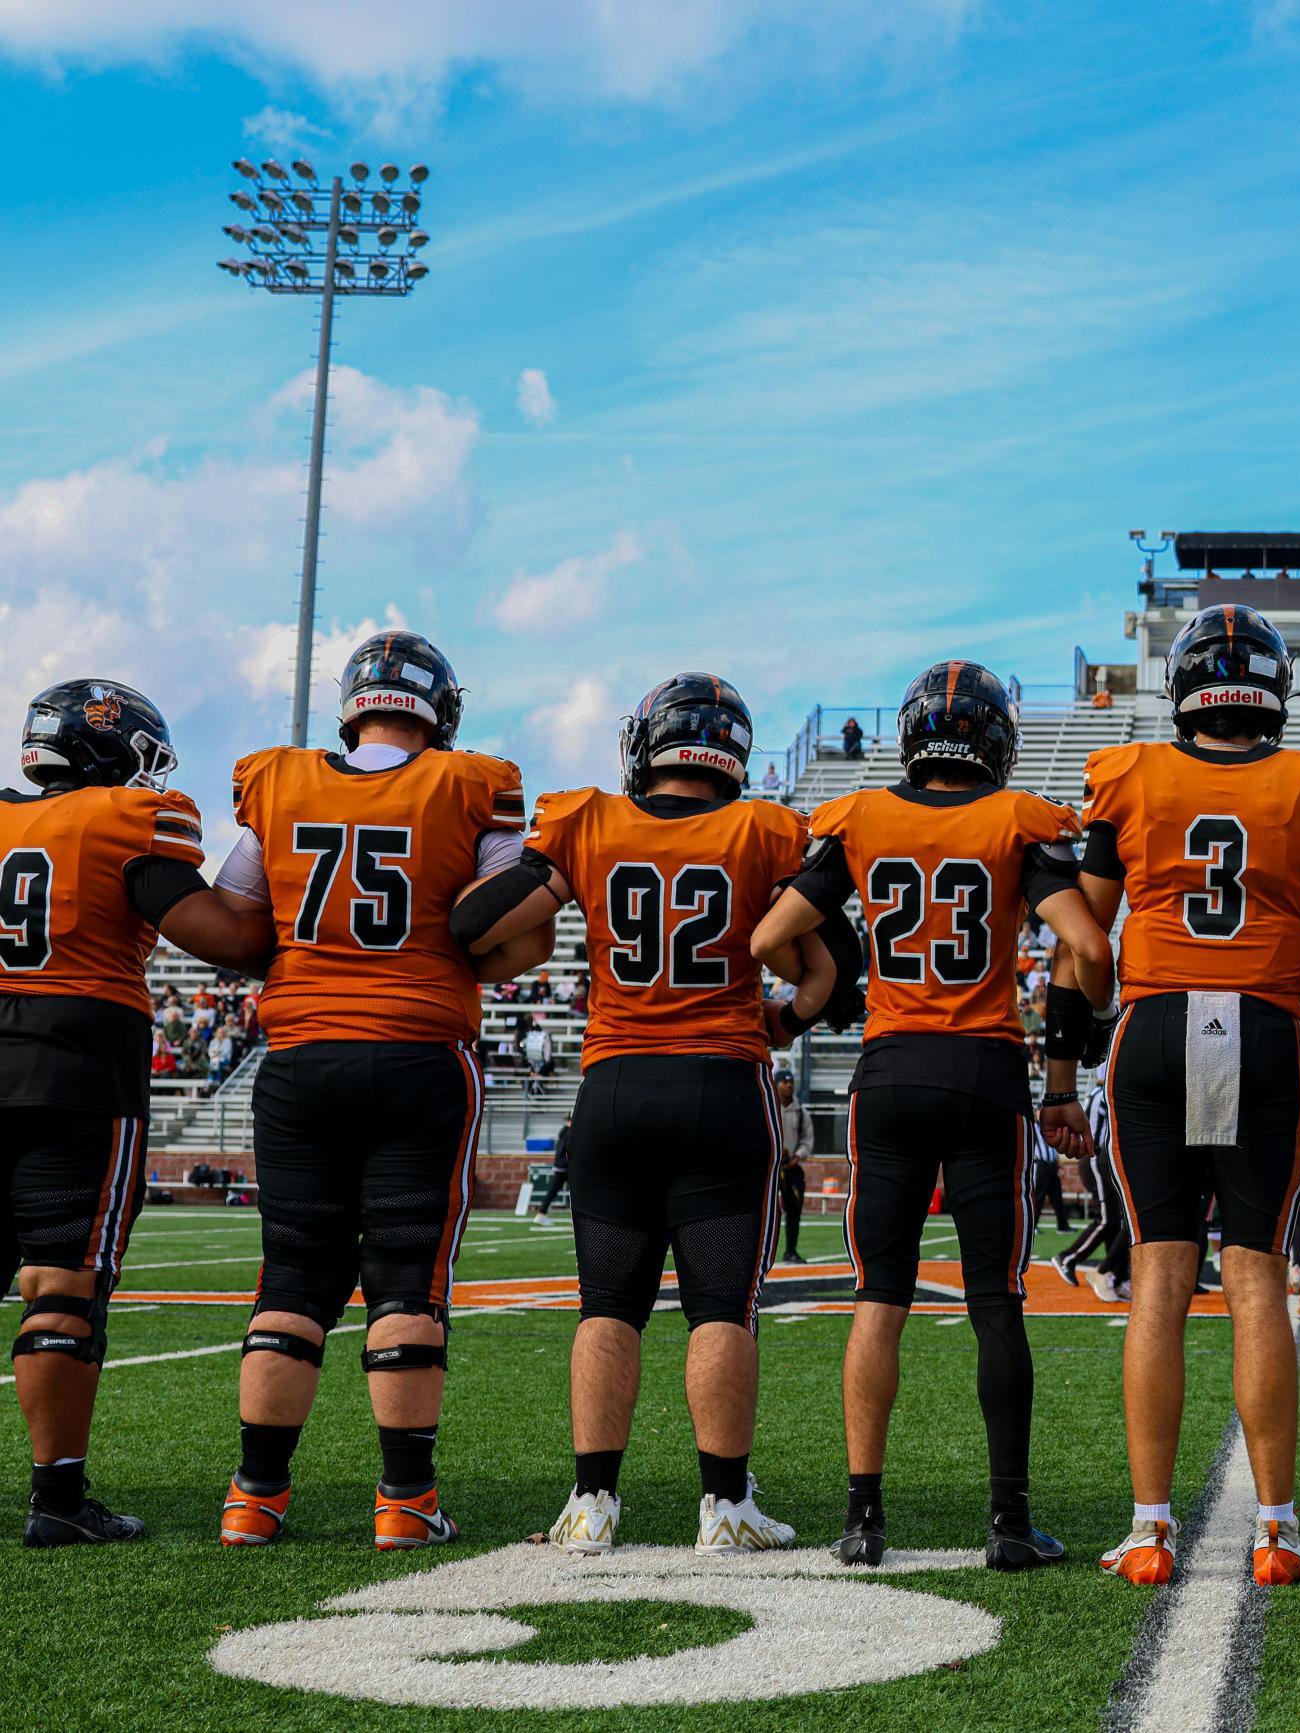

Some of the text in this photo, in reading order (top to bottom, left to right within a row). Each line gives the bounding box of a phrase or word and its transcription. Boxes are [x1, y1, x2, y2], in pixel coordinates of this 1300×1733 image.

[355, 693, 416, 710] Riddell
[1200, 690, 1263, 706] Riddell
[679, 749, 737, 772] Riddell
[292, 822, 412, 950] 75
[1183, 814, 1249, 940] 3
[606, 861, 733, 989] 92
[867, 857, 992, 985] 23
[1201, 1028, 1227, 1036] adidas
